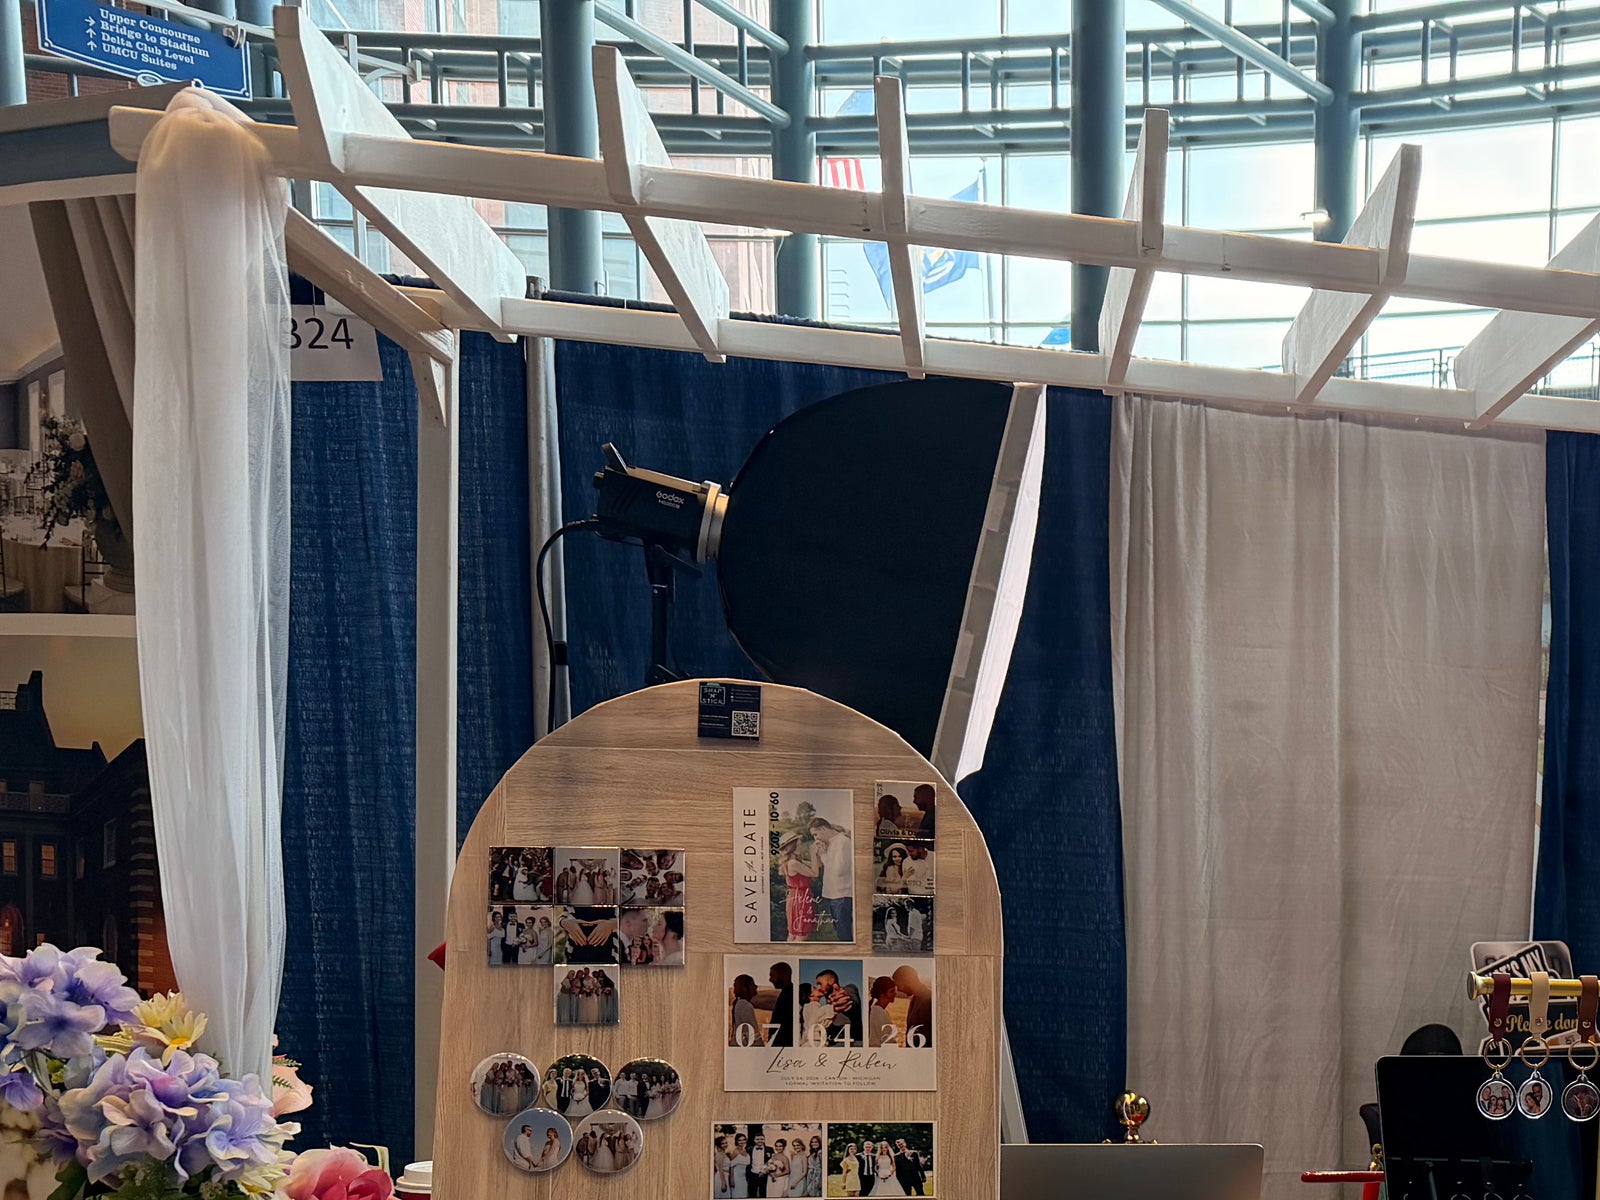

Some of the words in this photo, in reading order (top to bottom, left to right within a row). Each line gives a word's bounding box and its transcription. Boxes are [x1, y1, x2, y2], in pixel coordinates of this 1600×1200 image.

[100, 8, 137, 27] Upper
[139, 19, 201, 44] Concourse
[100, 20, 142, 40] Bridge
[145, 34, 157, 44] to
[160, 37, 210, 58] Stadium
[101, 32, 133, 48] Delta
[136, 42, 162, 56] Club
[165, 50, 195, 65] Level
[102, 43, 138, 60] UMCU
[141, 54, 177, 71] Suites
[655, 491, 685, 504] Godox
[743, 808, 757, 856] DATE
[743, 874, 758, 925] SAVE
[735, 1022, 782, 1048] 07
[807, 1022, 855, 1048] 04
[880, 1023, 928, 1049] 26
[1505, 1013, 1553, 1034] Plee
[766, 1045, 807, 1074] Lisa
[814, 1052, 828, 1068] &
[837, 1050, 897, 1079] Ruben
